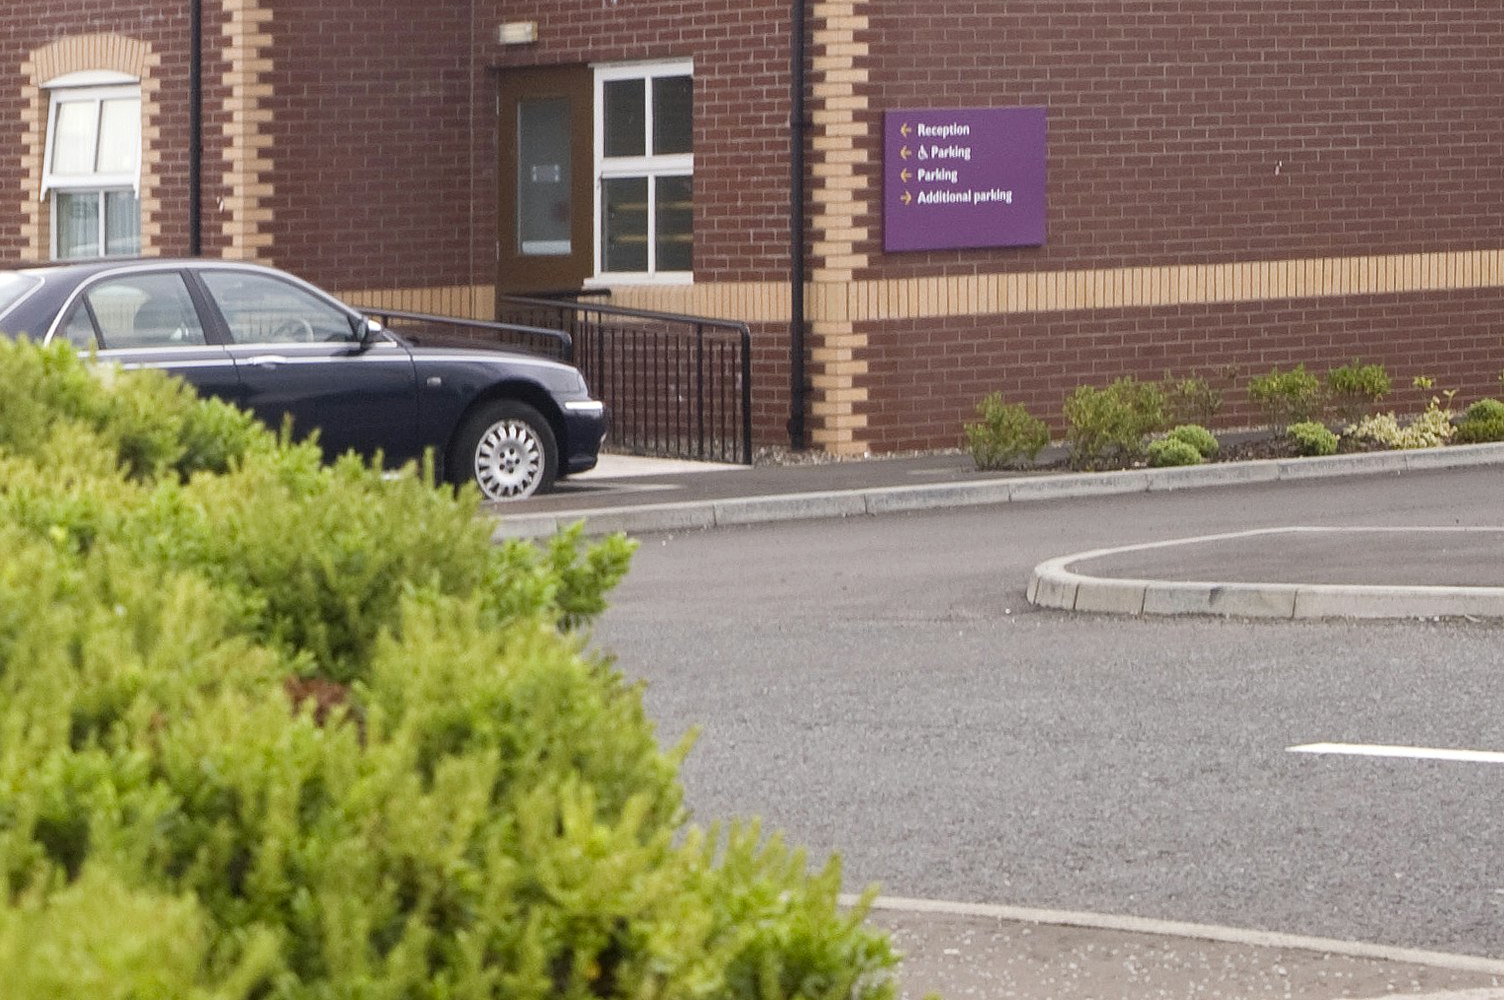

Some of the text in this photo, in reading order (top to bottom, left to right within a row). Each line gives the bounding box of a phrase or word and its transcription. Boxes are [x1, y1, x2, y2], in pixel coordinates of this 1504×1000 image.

[917, 123, 970, 139] Reception
[931, 145, 971, 160] Parking
[917, 168, 958, 183] Parking
[917, 188, 1012, 205] Additional parking
